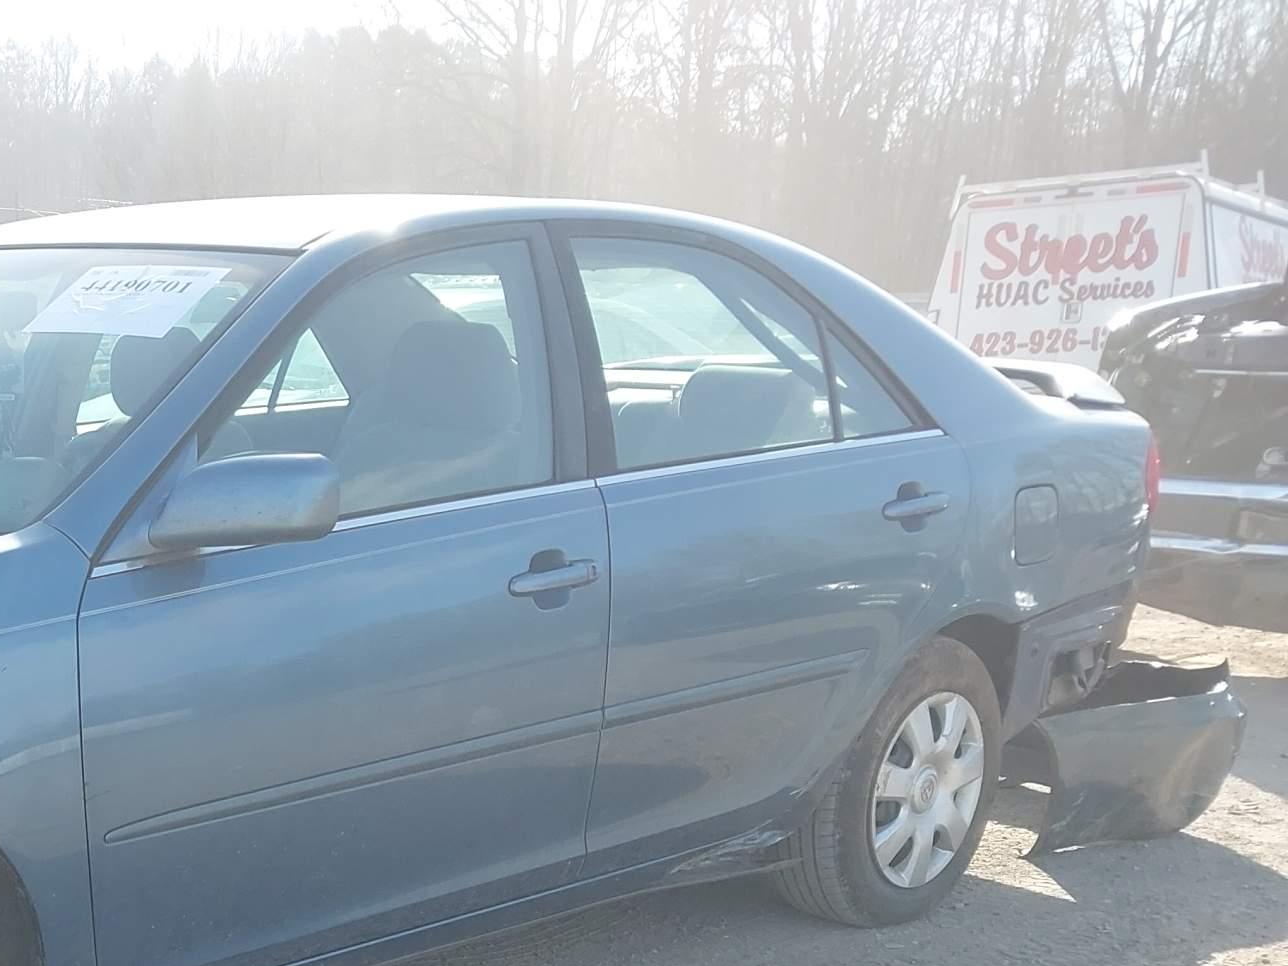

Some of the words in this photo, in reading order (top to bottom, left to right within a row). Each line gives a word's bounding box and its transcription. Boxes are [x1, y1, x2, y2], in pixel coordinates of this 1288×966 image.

[980, 214, 1159, 284] Street's
[80, 279, 193, 293] 44190701
[1058, 277, 1155, 302] Services
